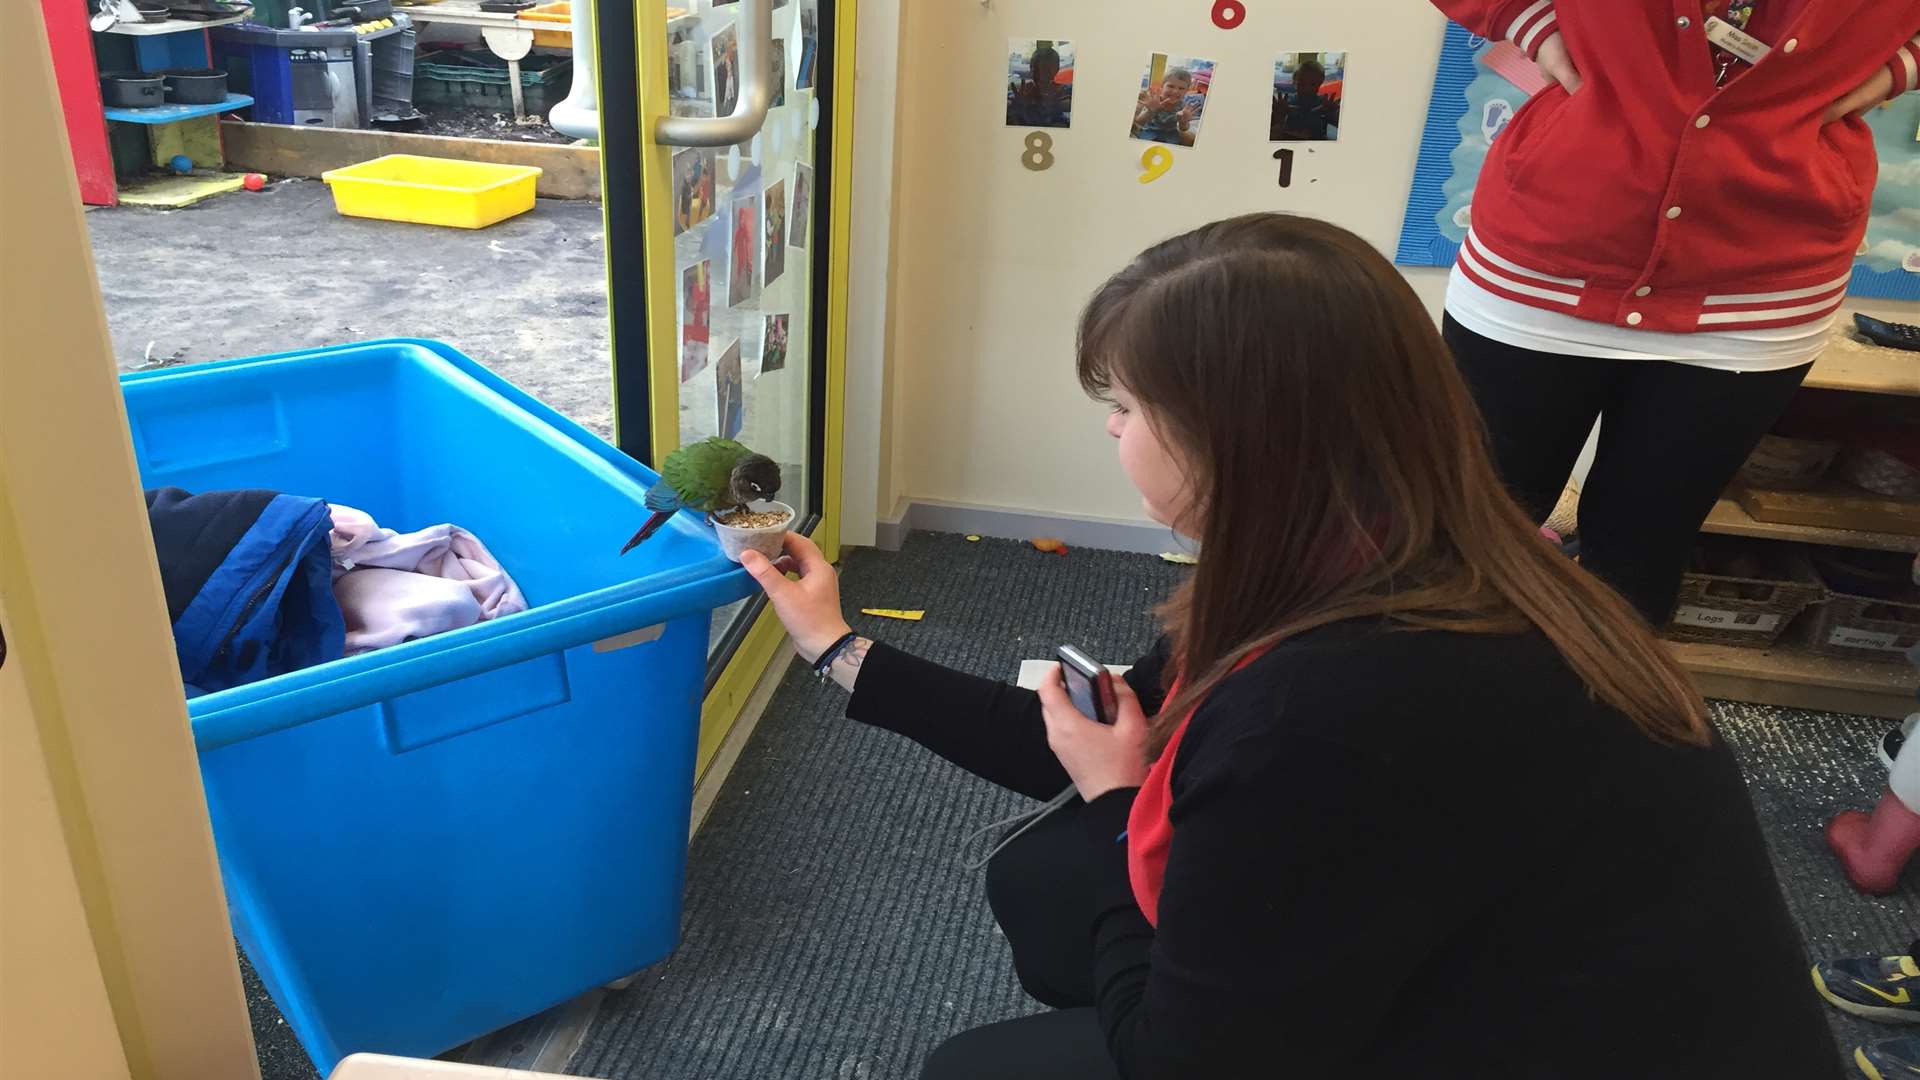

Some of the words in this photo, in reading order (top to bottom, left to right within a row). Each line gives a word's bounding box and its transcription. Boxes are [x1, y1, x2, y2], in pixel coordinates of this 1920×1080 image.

[1021, 131, 1055, 171] 8
[1139, 145, 1174, 184] 9
[1273, 149, 1294, 188] 1
